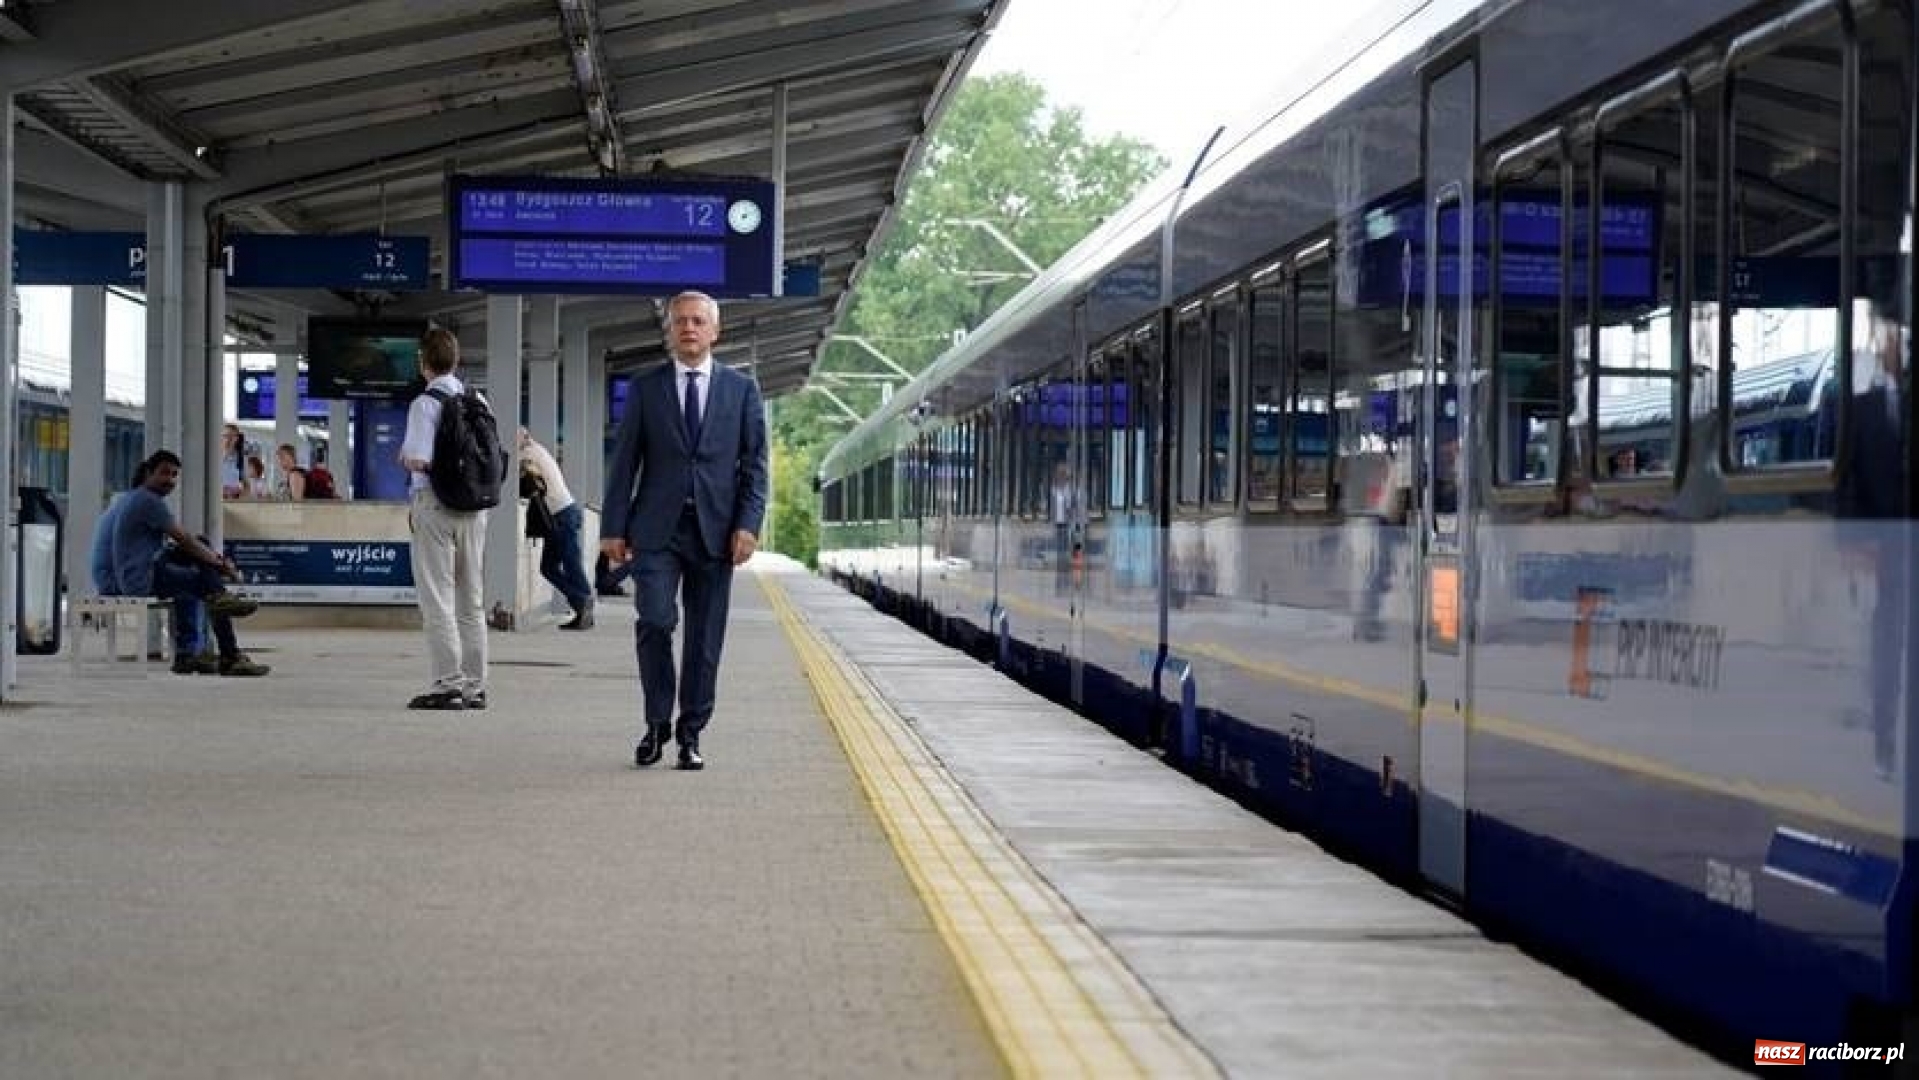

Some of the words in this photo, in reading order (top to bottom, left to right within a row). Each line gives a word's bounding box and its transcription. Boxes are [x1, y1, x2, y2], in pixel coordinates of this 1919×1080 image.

[684, 203, 714, 227] 12
[375, 252, 395, 268] 12
[331, 544, 397, 563] wyjście
